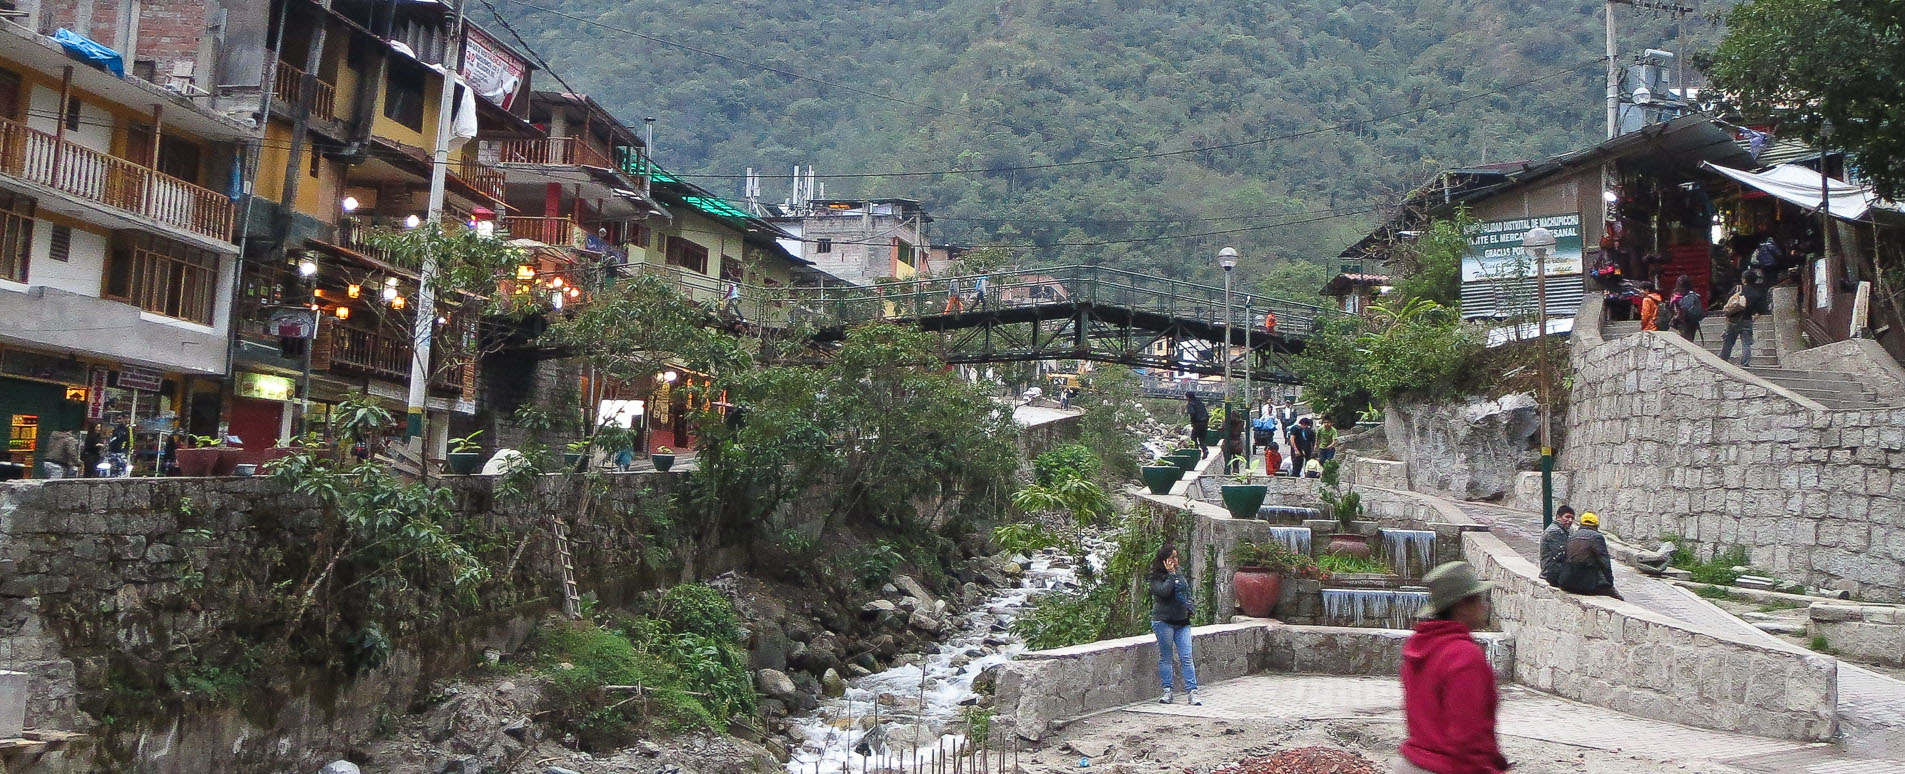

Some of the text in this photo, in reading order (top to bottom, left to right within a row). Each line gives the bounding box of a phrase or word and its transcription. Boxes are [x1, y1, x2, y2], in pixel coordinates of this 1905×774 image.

[1503, 219, 1530, 231] DISTRITAL
[1531, 218, 1539, 228] DE
[1539, 214, 1579, 228] MACHUPICCHU
[1490, 235, 1499, 243] EL
[1484, 248, 1511, 258] GRACIAS
